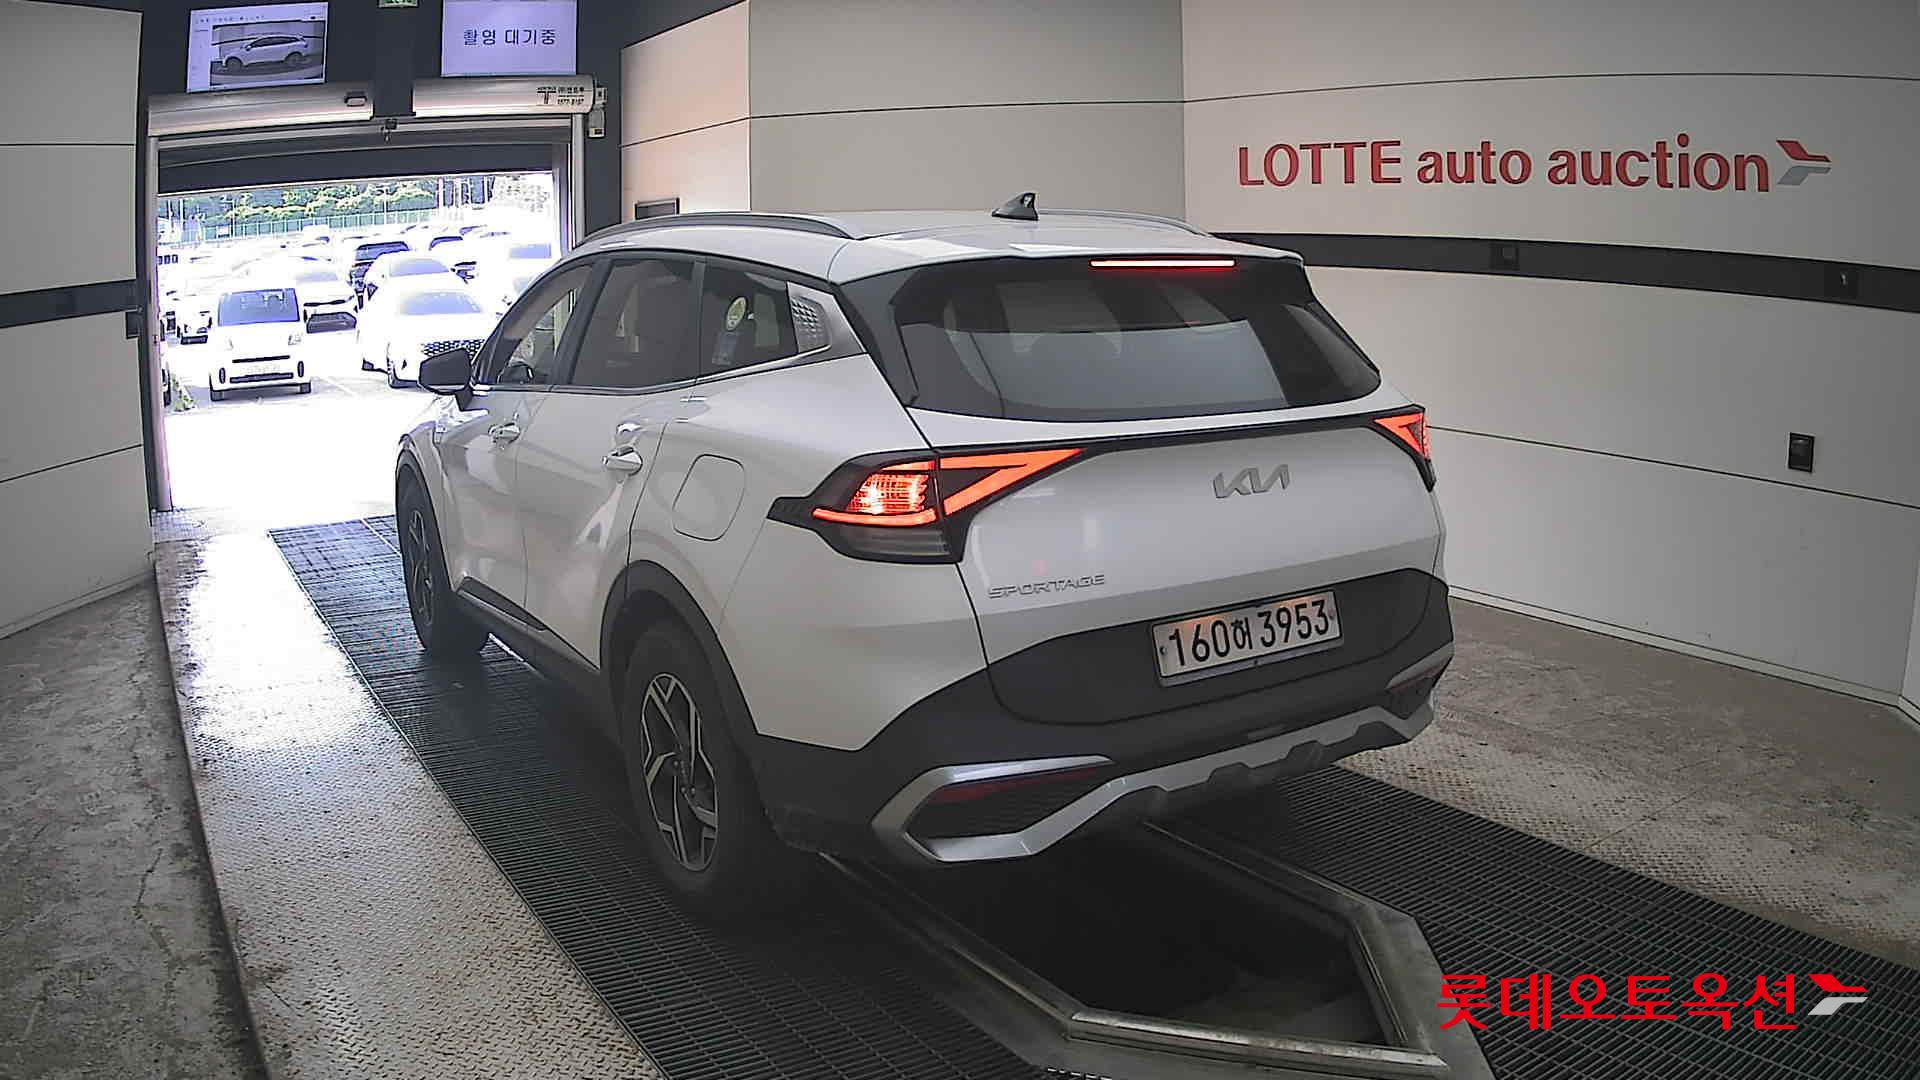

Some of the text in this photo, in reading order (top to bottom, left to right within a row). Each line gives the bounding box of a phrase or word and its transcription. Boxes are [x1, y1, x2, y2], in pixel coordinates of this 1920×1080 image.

[504, 28, 557, 46] 대기중
[1239, 133, 1770, 193] LOTTE auto auction
[1212, 463, 1290, 499] KIA
[988, 574, 1105, 600] SPORTAGE
